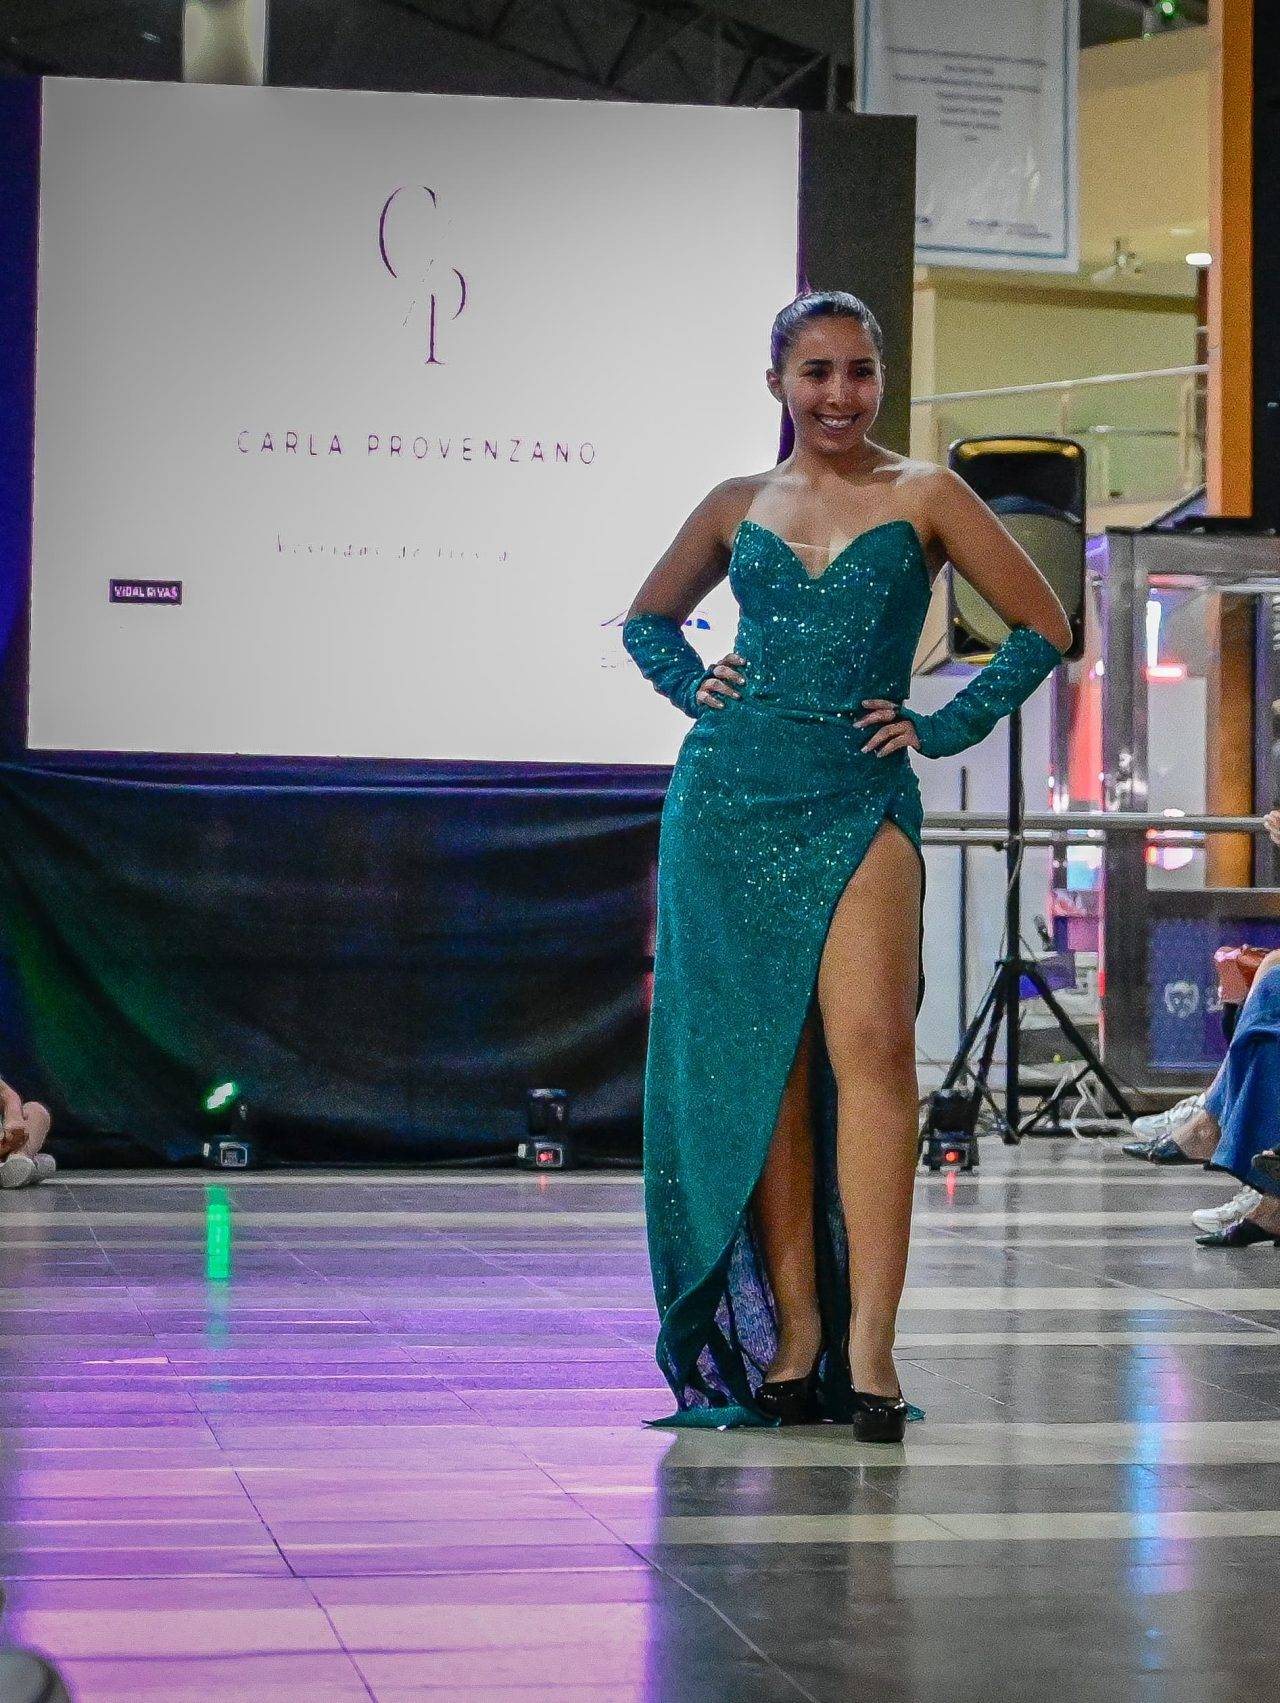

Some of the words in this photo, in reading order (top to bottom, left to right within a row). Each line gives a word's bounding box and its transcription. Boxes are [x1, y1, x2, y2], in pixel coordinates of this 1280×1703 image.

[237, 430, 342, 456] CARLA
[367, 434, 595, 465] PROVENZANO
[114, 585, 145, 598] VIDAL
